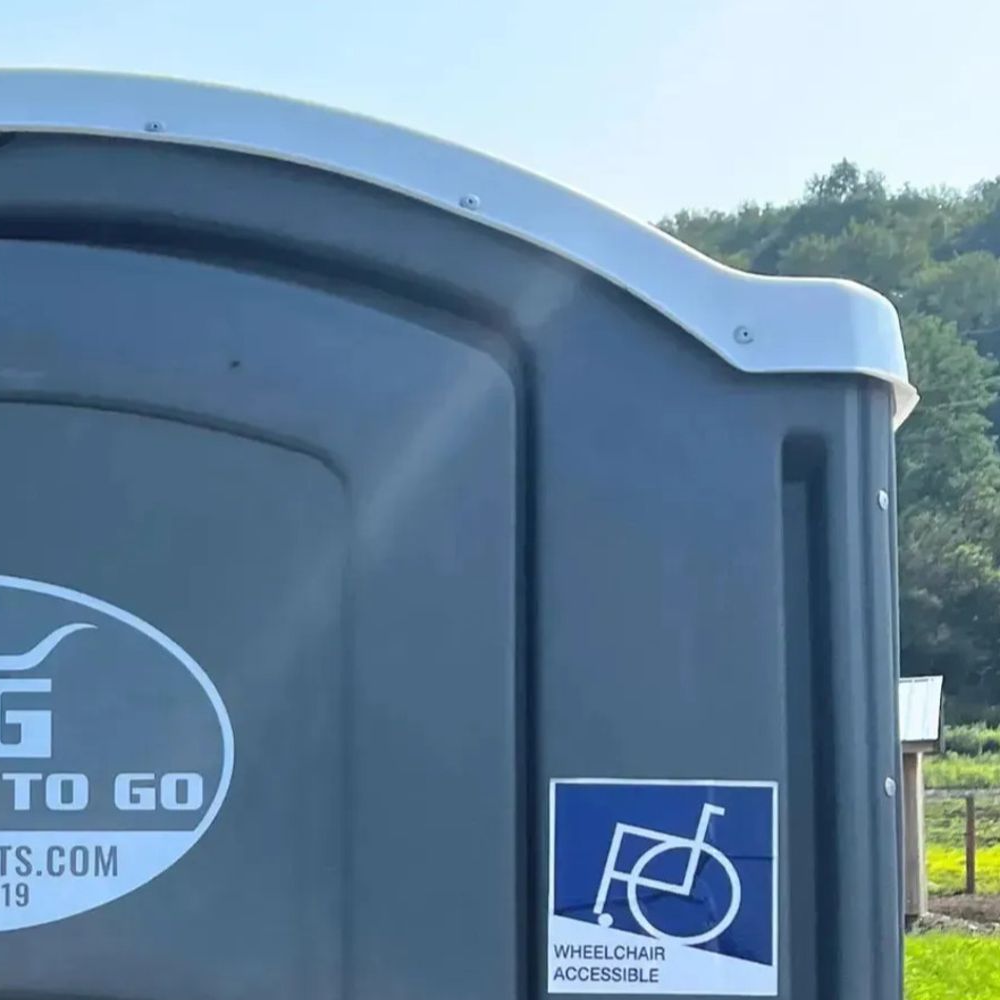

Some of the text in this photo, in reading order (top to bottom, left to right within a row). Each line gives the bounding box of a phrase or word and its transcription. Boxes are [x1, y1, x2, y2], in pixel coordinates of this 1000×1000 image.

[2, 772, 89, 811] TO
[114, 772, 204, 811] GO
[553, 944, 666, 961] WHEELCHAIR
[553, 966, 659, 983] ACCESSIBLE
